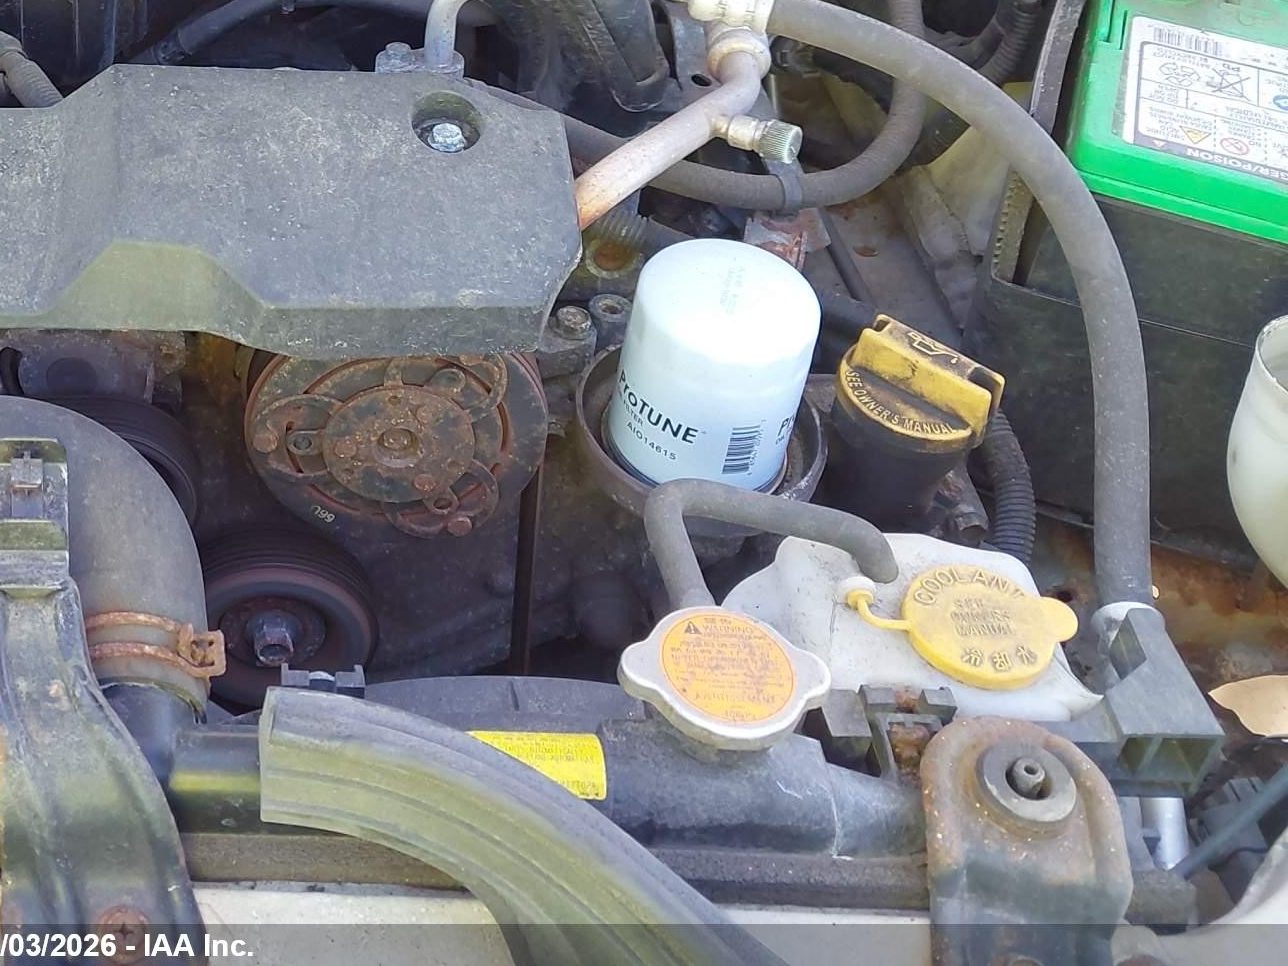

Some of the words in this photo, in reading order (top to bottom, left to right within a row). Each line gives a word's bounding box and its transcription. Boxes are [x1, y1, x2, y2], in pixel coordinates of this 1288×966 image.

[619, 369, 699, 444] ProTUNE
[845, 370, 863, 388] SEE
[854, 389, 900, 425] OWNER'S
[903, 418, 956, 435] MANUAL
[913, 567, 1026, 605] COOLANT
